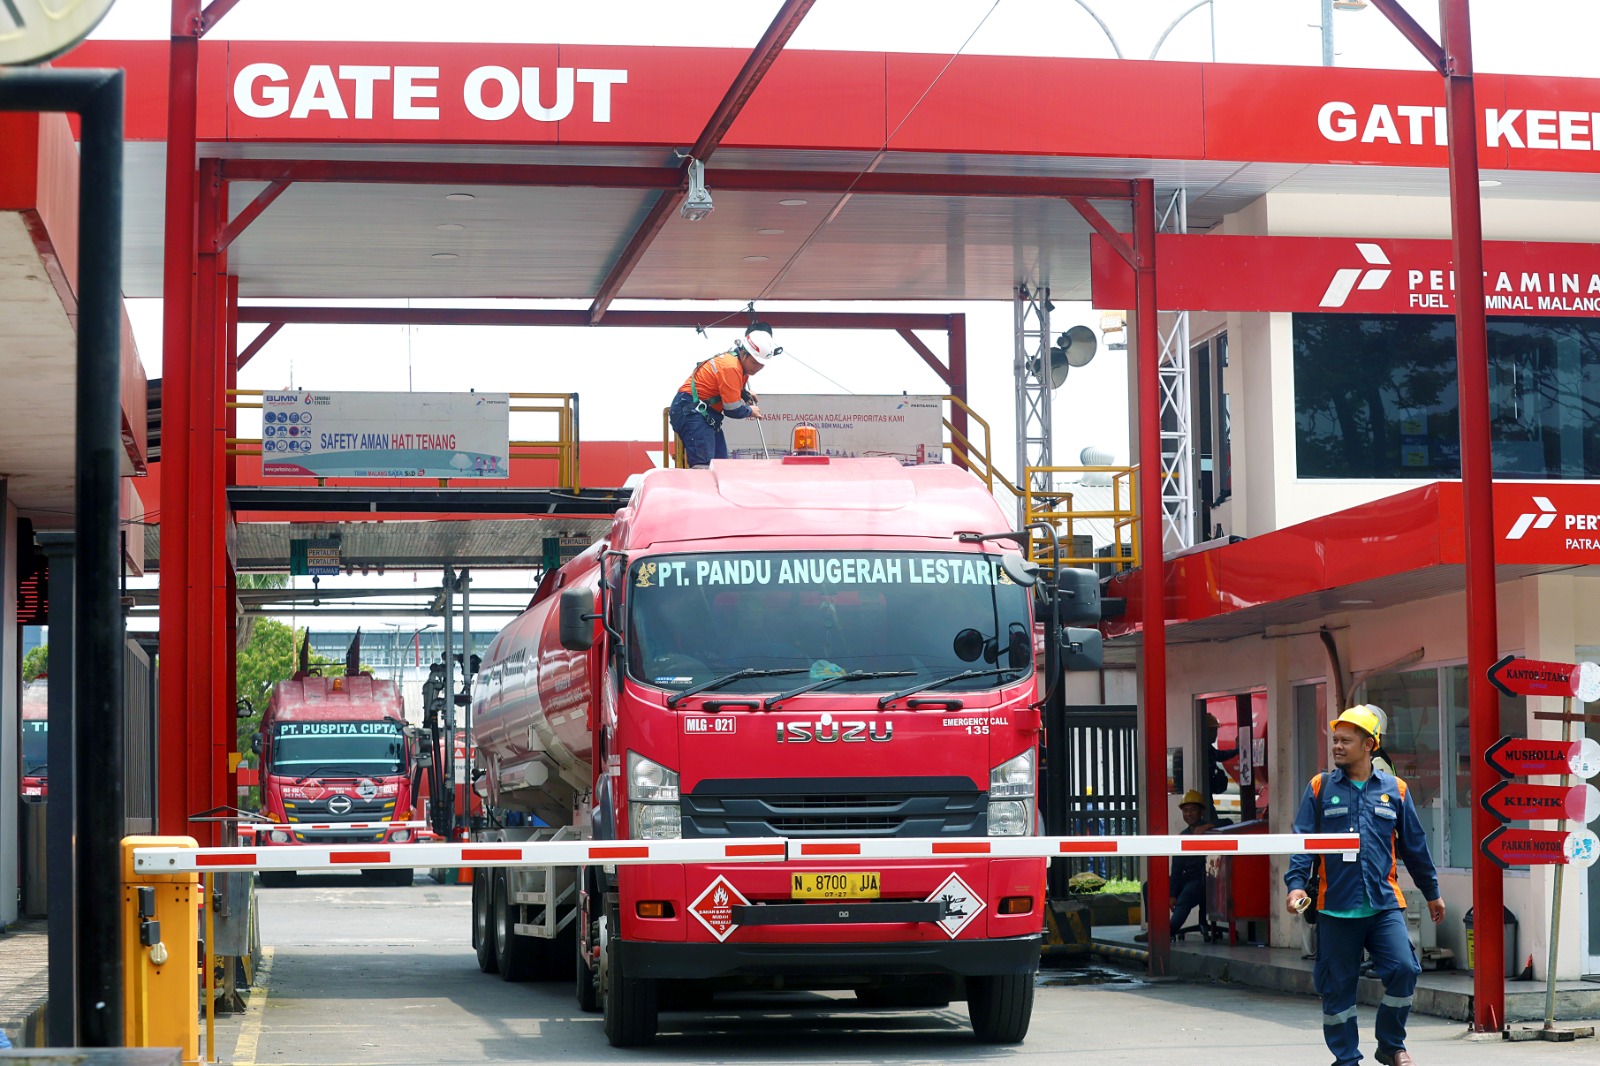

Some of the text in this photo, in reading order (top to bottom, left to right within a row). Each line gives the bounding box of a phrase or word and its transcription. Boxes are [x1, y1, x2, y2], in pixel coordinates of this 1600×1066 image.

[233, 62, 628, 123] GATE OUT
[1485, 108, 1600, 151] KEE
[1408, 269, 1600, 294] PEAMINA
[1409, 293, 1448, 309] FUEL
[1454, 295, 1534, 310] MINAL
[782, 413, 823, 422] PELANGGAN
[825, 413, 852, 422] ADALAH
[853, 414, 888, 423] PRIORITAS
[888, 415, 905, 423] KAMI
[321, 433, 456, 450] SAFETY AMAN HATI TENANG
[1565, 514, 1600, 530] PER
[659, 558, 998, 588] PT. PANDU ANUGERAH LESTARI
[1506, 669, 1540, 680] KANTOR
[280, 723, 398, 735] PT. PUSPITA CIPTA
[686, 718, 708, 732] MLG
[715, 718, 733, 732] 021
[942, 717, 1009, 727] EMERGENCY CALL
[776, 720, 893, 744] ISUZU
[965, 725, 990, 735] 135
[1504, 749, 1565, 761] MUSHOLLA
[1504, 796, 1562, 807] KLINIK
[1501, 840, 1562, 852] PARKIR MOTOR
[794, 874, 878, 891] N 8700 UA
